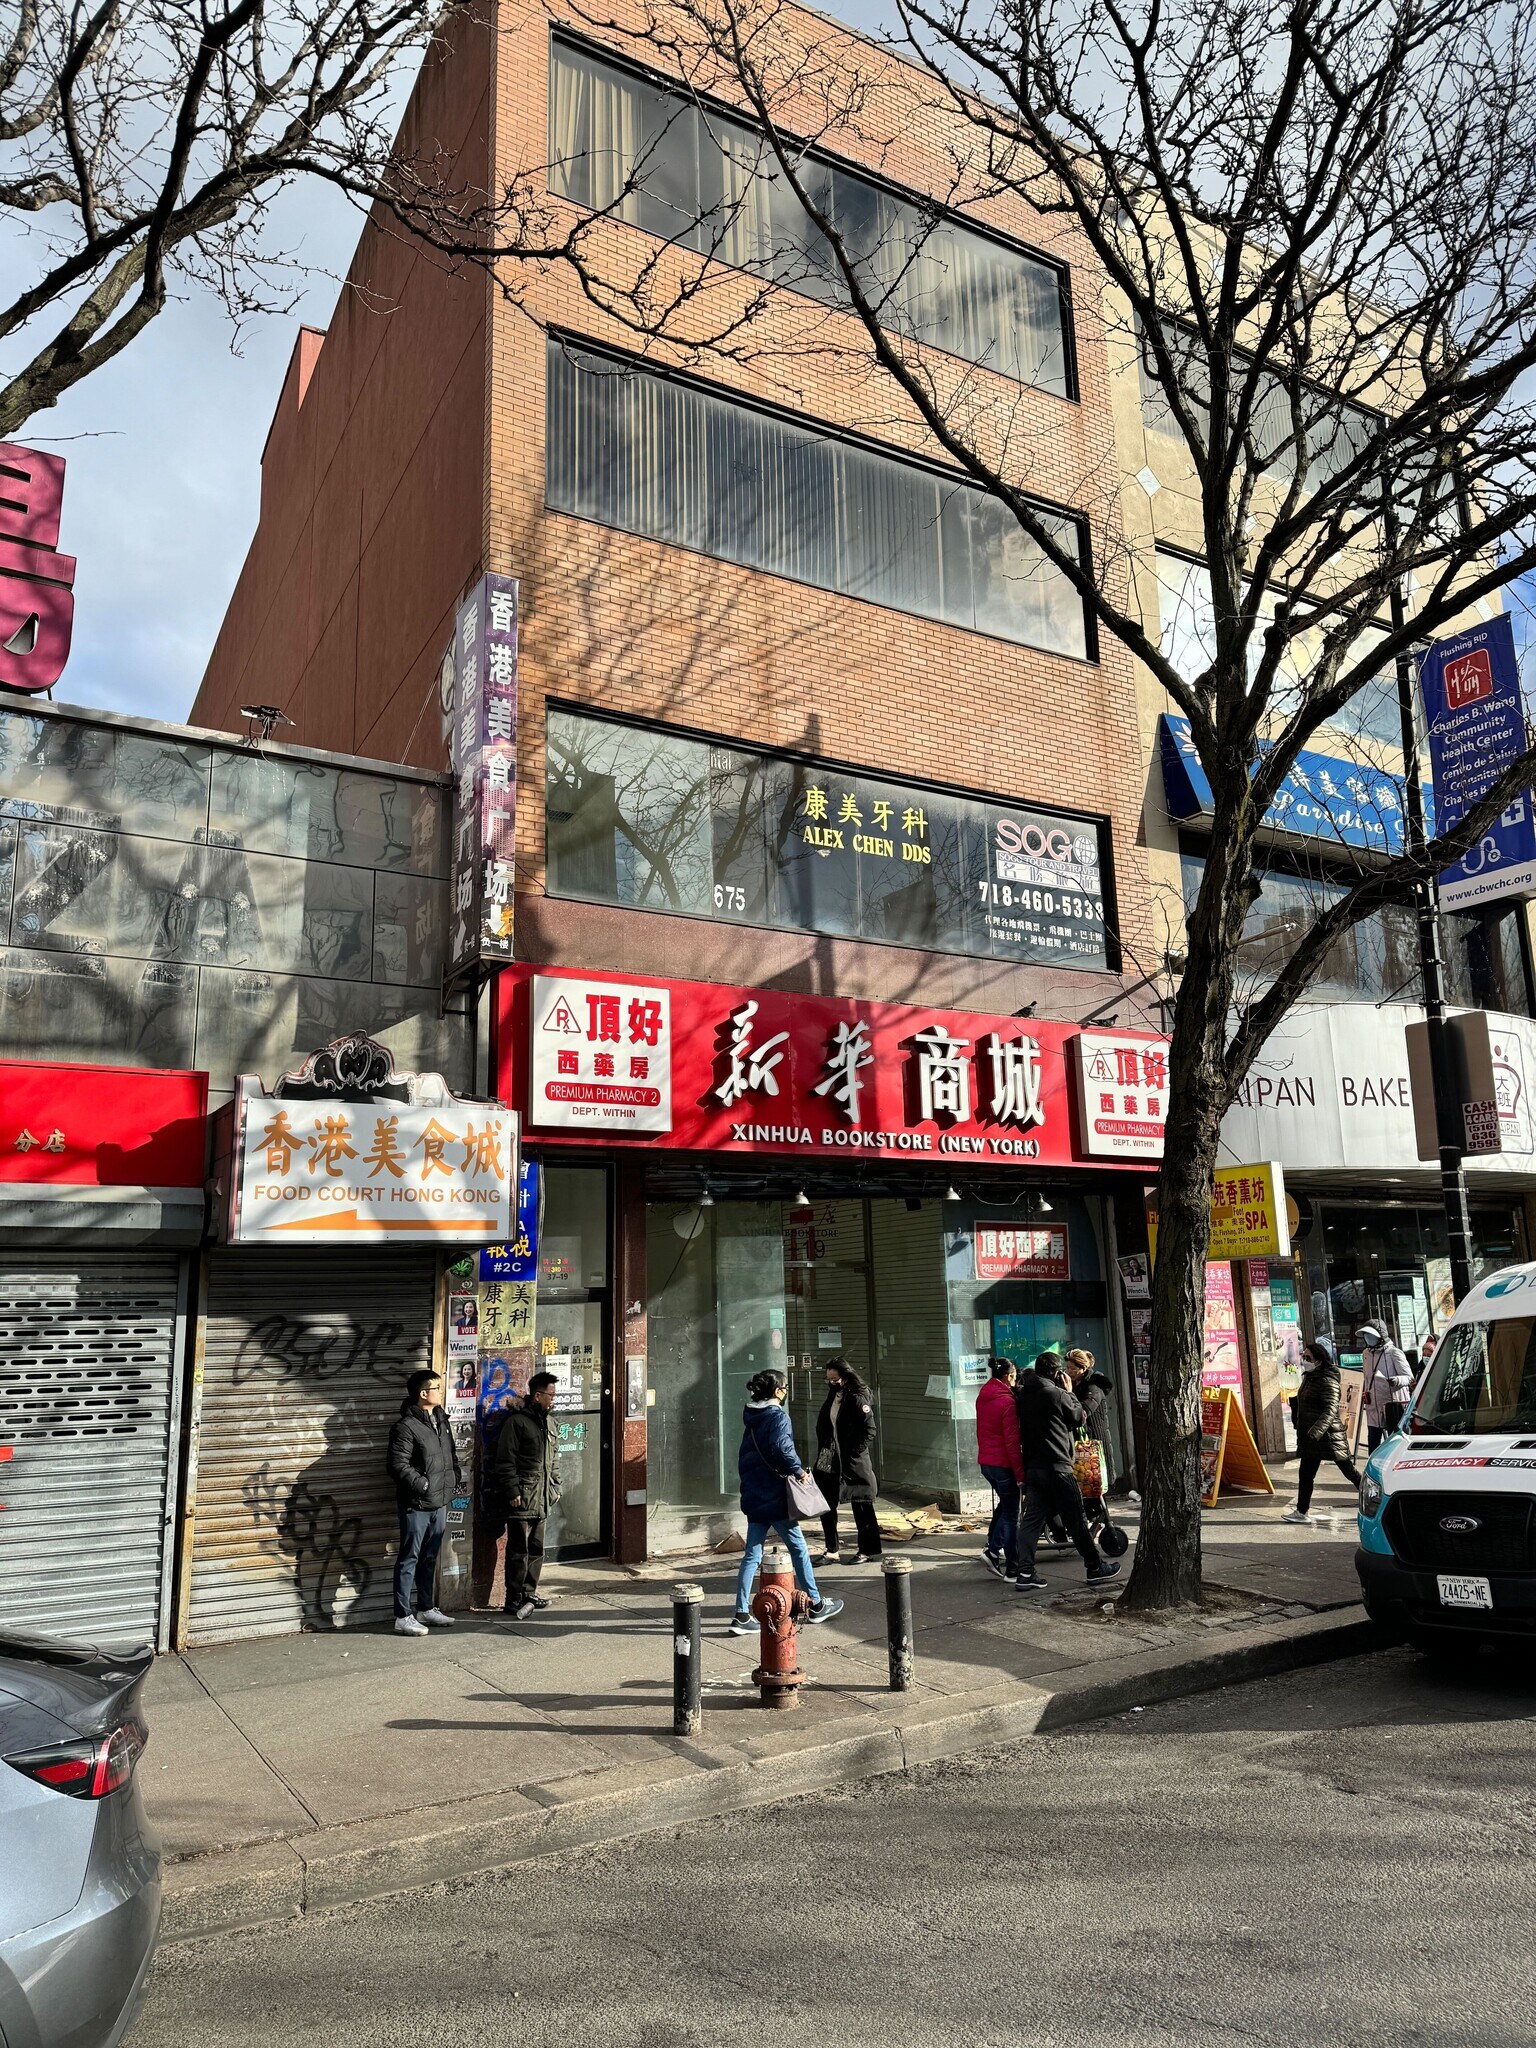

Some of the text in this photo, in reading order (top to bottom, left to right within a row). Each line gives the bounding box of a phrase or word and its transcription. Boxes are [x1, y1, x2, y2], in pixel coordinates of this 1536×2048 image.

[1440, 632, 1488, 658] Flushing BID
[1433, 696, 1516, 734] Charles B. Wang
[1444, 715, 1507, 745] Community
[484, 590, 514, 904] 香港美食广场
[1441, 728, 1514, 761] Health Center
[1474, 757, 1487, 768] de
[803, 785, 929, 839] 康美牙科
[803, 826, 932, 864] ALEX CHEN DDS
[1000, 852, 1099, 876] SOGO TOUR AND TRAVEL
[714, 885, 746, 911] 675
[1446, 873, 1532, 902] www.cbwchc.org
[978, 880, 1104, 922] 718-460-5338
[586, 994, 663, 1046] 頂好
[557, 1050, 649, 1079] 西藥房
[1114, 1048, 1166, 1090] 頂好
[550, 1084, 657, 1103] PREMIUM PHARMACY 2
[1495, 1076, 1512, 1107] 大班
[572, 1106, 636, 1118] DEPT. WITHIN
[1100, 1093, 1160, 1116] 西藥房
[1097, 1121, 1160, 1136] PREMIUM PHARMACY
[1468, 1122, 1497, 1133] (516)
[1471, 1131, 1496, 1141] 636
[13, 1128, 66, 1152] 分店
[252, 1110, 505, 1180] 香港美食城
[732, 1123, 1041, 1158] XINHUA BOOKSTORE (NEW YORK)
[1113, 1138, 1154, 1148] DEPT. WITHIN
[1468, 1138, 1500, 1149] 9595
[254, 1185, 501, 1204] FOOD COURT HONG KONG
[1245, 1210, 1268, 1230] SPA
[981, 1230, 1065, 1259] 頂好西藥房
[494, 1262, 522, 1272] #2C
[981, 1263, 1012, 1273] PREMIUM
[1014, 1265, 1048, 1274] PHARMACY
[1051, 1265, 1056, 1274] 2
[483, 1283, 531, 1304] 康美
[483, 1307, 530, 1328] 牙科
[450, 1343, 477, 1351] Wendy
[496, 1332, 512, 1345] 2A
[541, 1337, 558, 1355] 牌
[447, 1406, 475, 1415] Wendy
[1397, 1458, 1486, 1469] EMERGENCY
[1446, 1519, 1467, 1530] Ford
